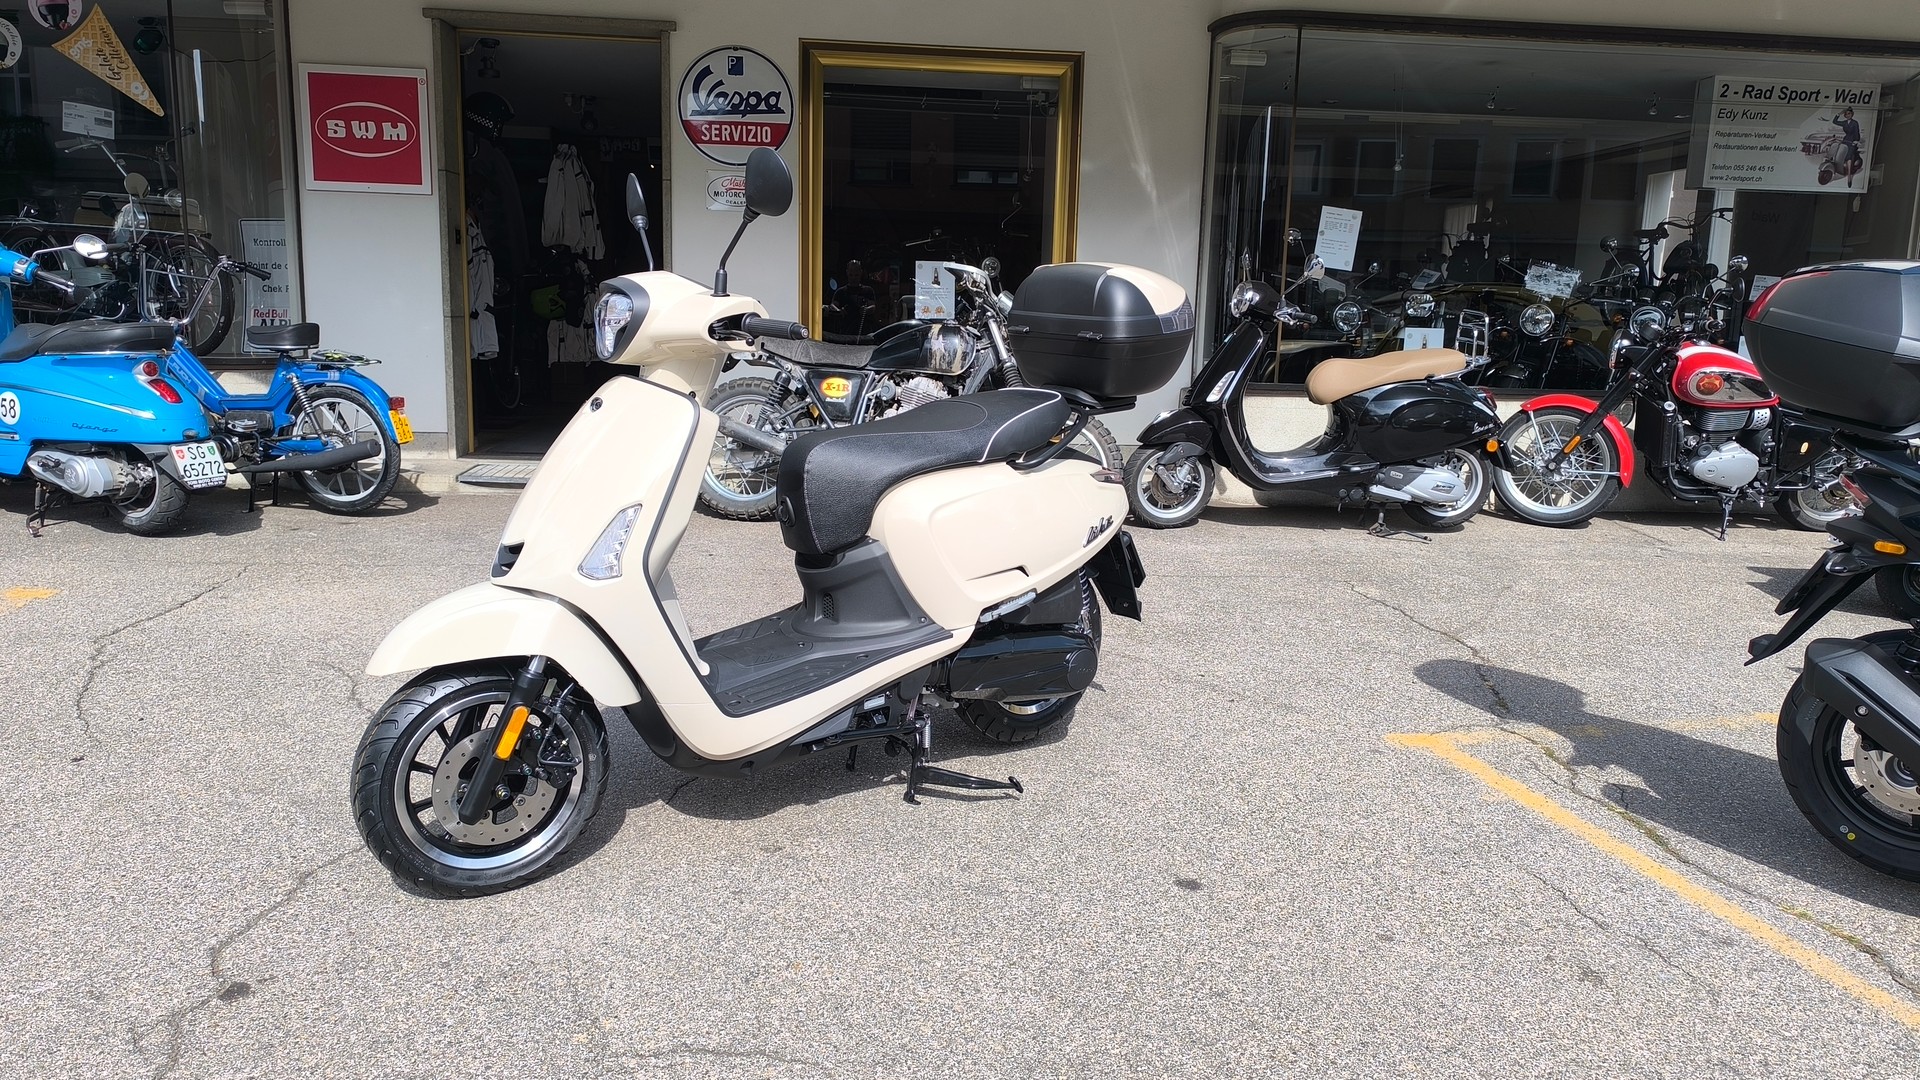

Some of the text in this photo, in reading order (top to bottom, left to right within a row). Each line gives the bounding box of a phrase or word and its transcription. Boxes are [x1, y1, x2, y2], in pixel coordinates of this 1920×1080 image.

[100, 27, 129, 69] Collection
[96, 48, 121, 80] Gelato
[689, 64, 786, 119] Vespa
[1720, 84, 1730, 98] 2
[1742, 85, 1774, 100] Rad
[1778, 86, 1821, 104] Sport
[1835, 88, 1873, 104] Wald
[1717, 108, 1768, 121] Edy Kunz
[326, 119, 407, 141] SWM
[701, 124, 772, 143] SERVIZIO
[1715, 131, 1777, 139] Reparaturen-Verkauf
[1713, 143, 1758, 151] Restaurationen
[1711, 163, 1732, 171] Telefon
[713, 190, 746, 198] MOTORCY
[247, 262, 269, 270] Point
[271, 261, 282, 269] de
[262, 285, 283, 293] Chek
[253, 309, 288, 318] Red Bull
[824, 383, 850, 392] X-1R
[0, 398, 17, 419] 58
[187, 445, 206, 460] SG
[183, 460, 224, 479] 65272
